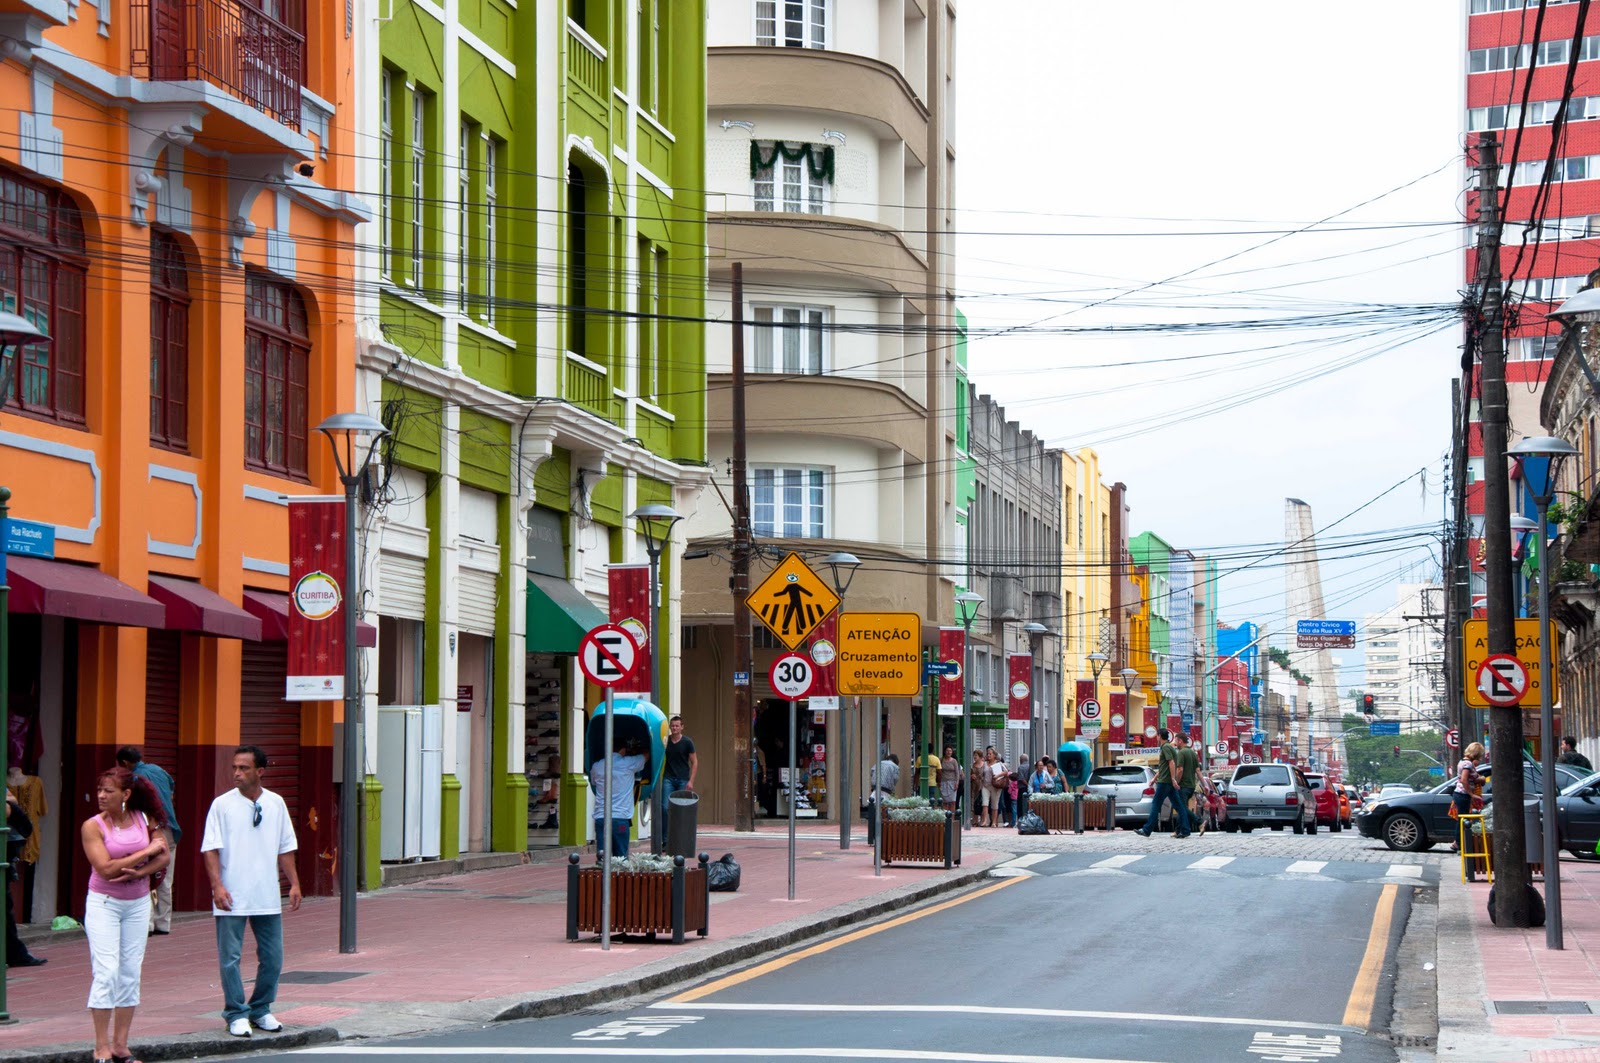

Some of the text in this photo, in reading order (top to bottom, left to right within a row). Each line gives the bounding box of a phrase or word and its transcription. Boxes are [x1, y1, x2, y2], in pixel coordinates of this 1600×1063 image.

[12, 526, 42, 539] Rua Riachuelo
[300, 592, 334, 600] CURITIBA
[847, 628, 911, 642] ATENÇÃO
[841, 652, 917, 662] Cruzamento
[778, 662, 806, 683] 30
[854, 669, 903, 678] elevado
[1086, 703, 1095, 715] E
